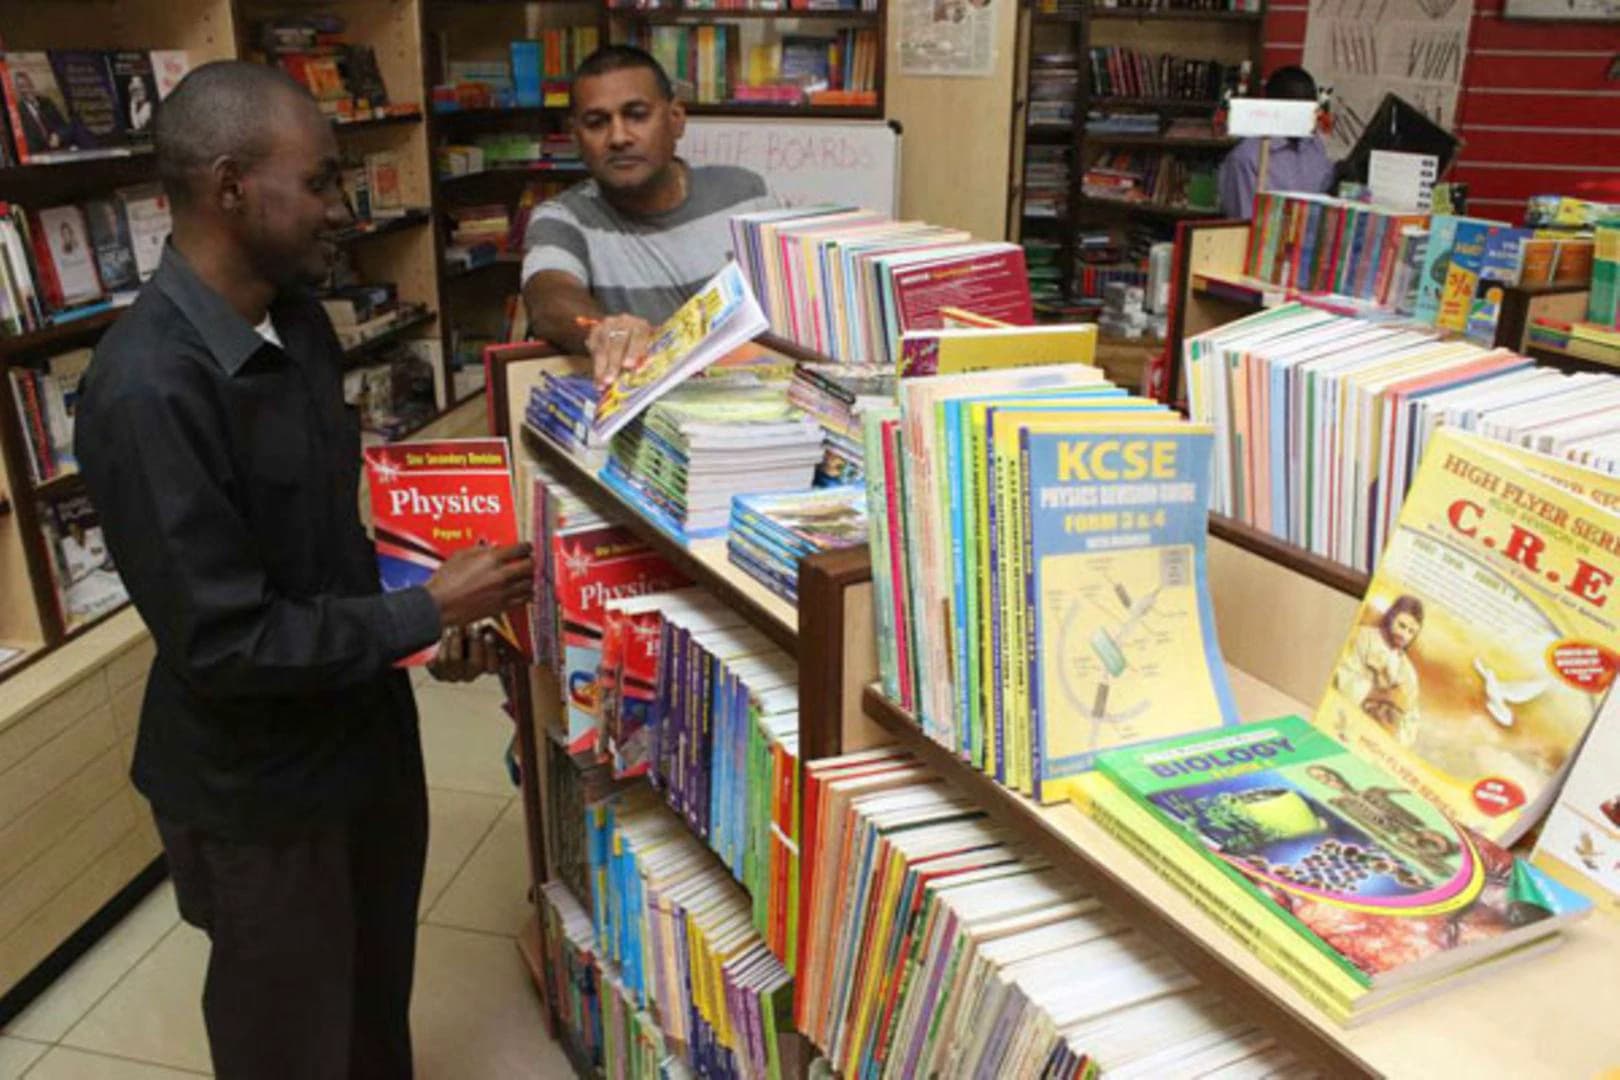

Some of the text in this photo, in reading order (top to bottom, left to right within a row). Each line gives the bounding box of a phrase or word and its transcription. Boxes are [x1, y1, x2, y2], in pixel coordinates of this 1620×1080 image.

[1057, 440, 1177, 481] KCSE
[389, 485, 501, 521] Physics
[1444, 453, 1501, 493] HIGH
[1501, 481, 1569, 529] FLYER
[1151, 737, 1296, 779] BIOLOGY
